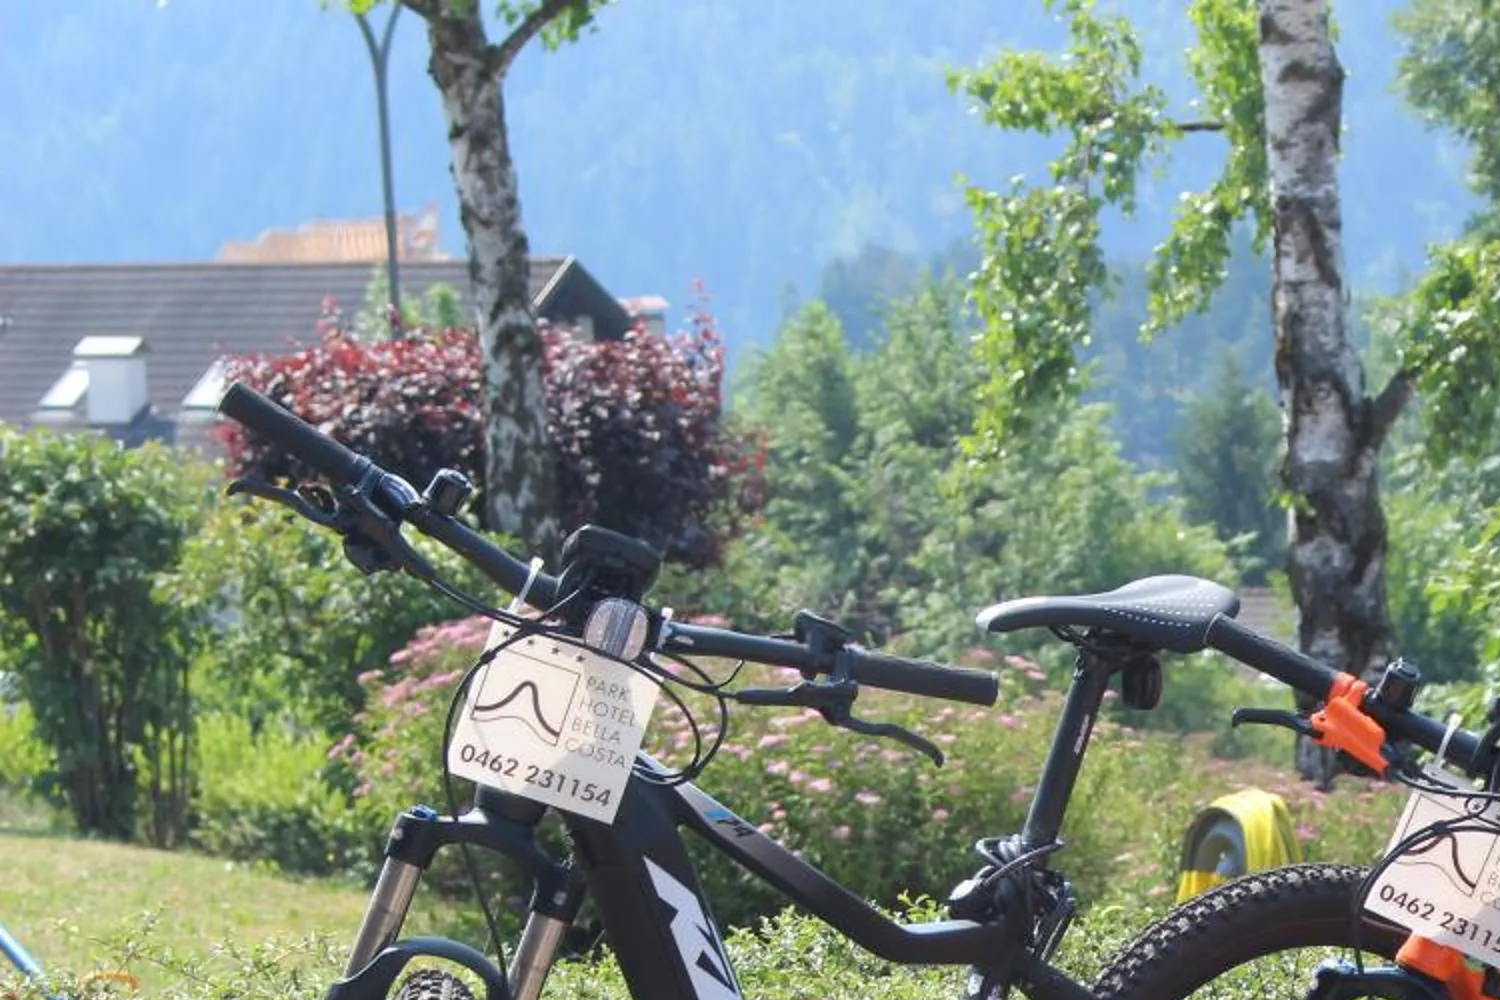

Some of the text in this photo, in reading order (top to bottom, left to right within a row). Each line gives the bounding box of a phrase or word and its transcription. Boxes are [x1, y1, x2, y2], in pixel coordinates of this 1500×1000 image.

[585, 676, 631, 701] PARK
[579, 697, 636, 727] HOTEL
[571, 718, 622, 744] BELLA
[565, 737, 627, 768] COSTA
[460, 743, 612, 807] 0462 231154
[1379, 884, 1436, 921] 0462
